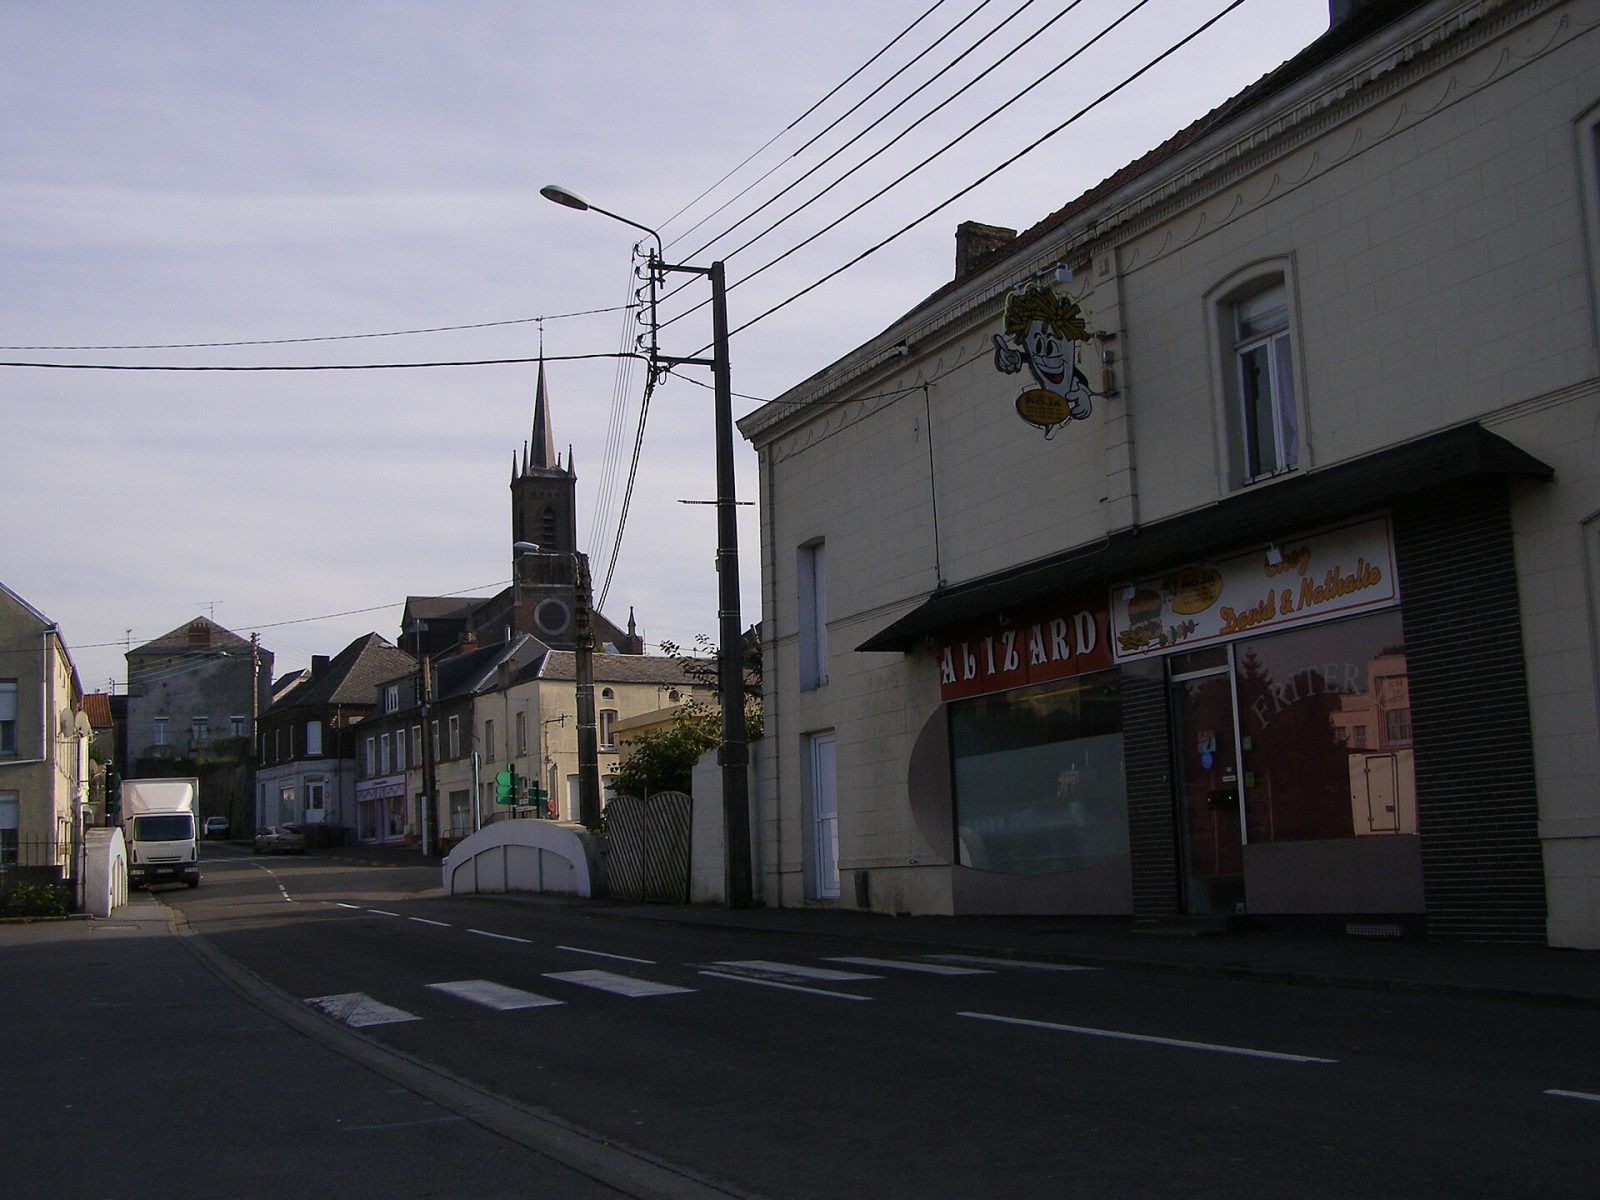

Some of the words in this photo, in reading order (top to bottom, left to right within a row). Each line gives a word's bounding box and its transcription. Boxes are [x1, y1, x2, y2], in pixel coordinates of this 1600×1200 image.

[1220, 589, 1276, 635] David
[1280, 589, 1295, 615] &
[1296, 557, 1382, 610] Nathalie
